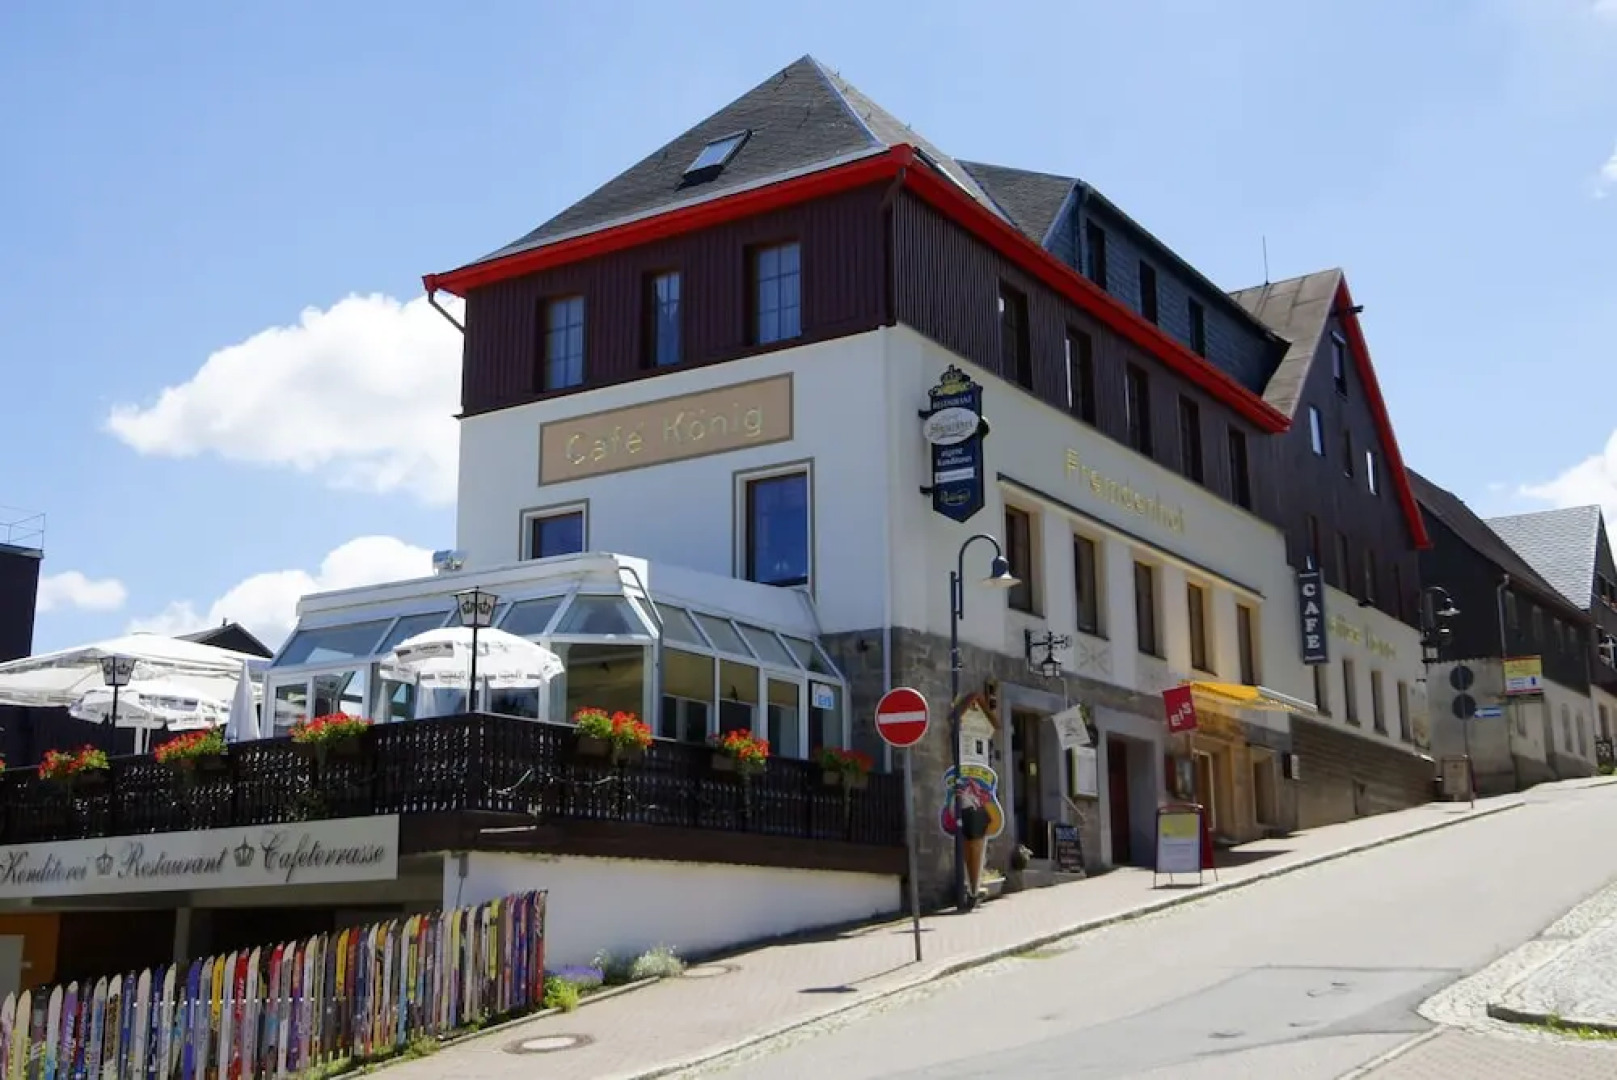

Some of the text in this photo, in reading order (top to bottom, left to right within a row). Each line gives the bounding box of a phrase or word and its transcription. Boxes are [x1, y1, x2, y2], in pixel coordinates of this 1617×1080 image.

[565, 403, 763, 466] Café König
[1302, 583, 1320, 649] CAFE
[117, 840, 229, 879] Restaurant
[260, 829, 386, 884] Cafeterrasse
